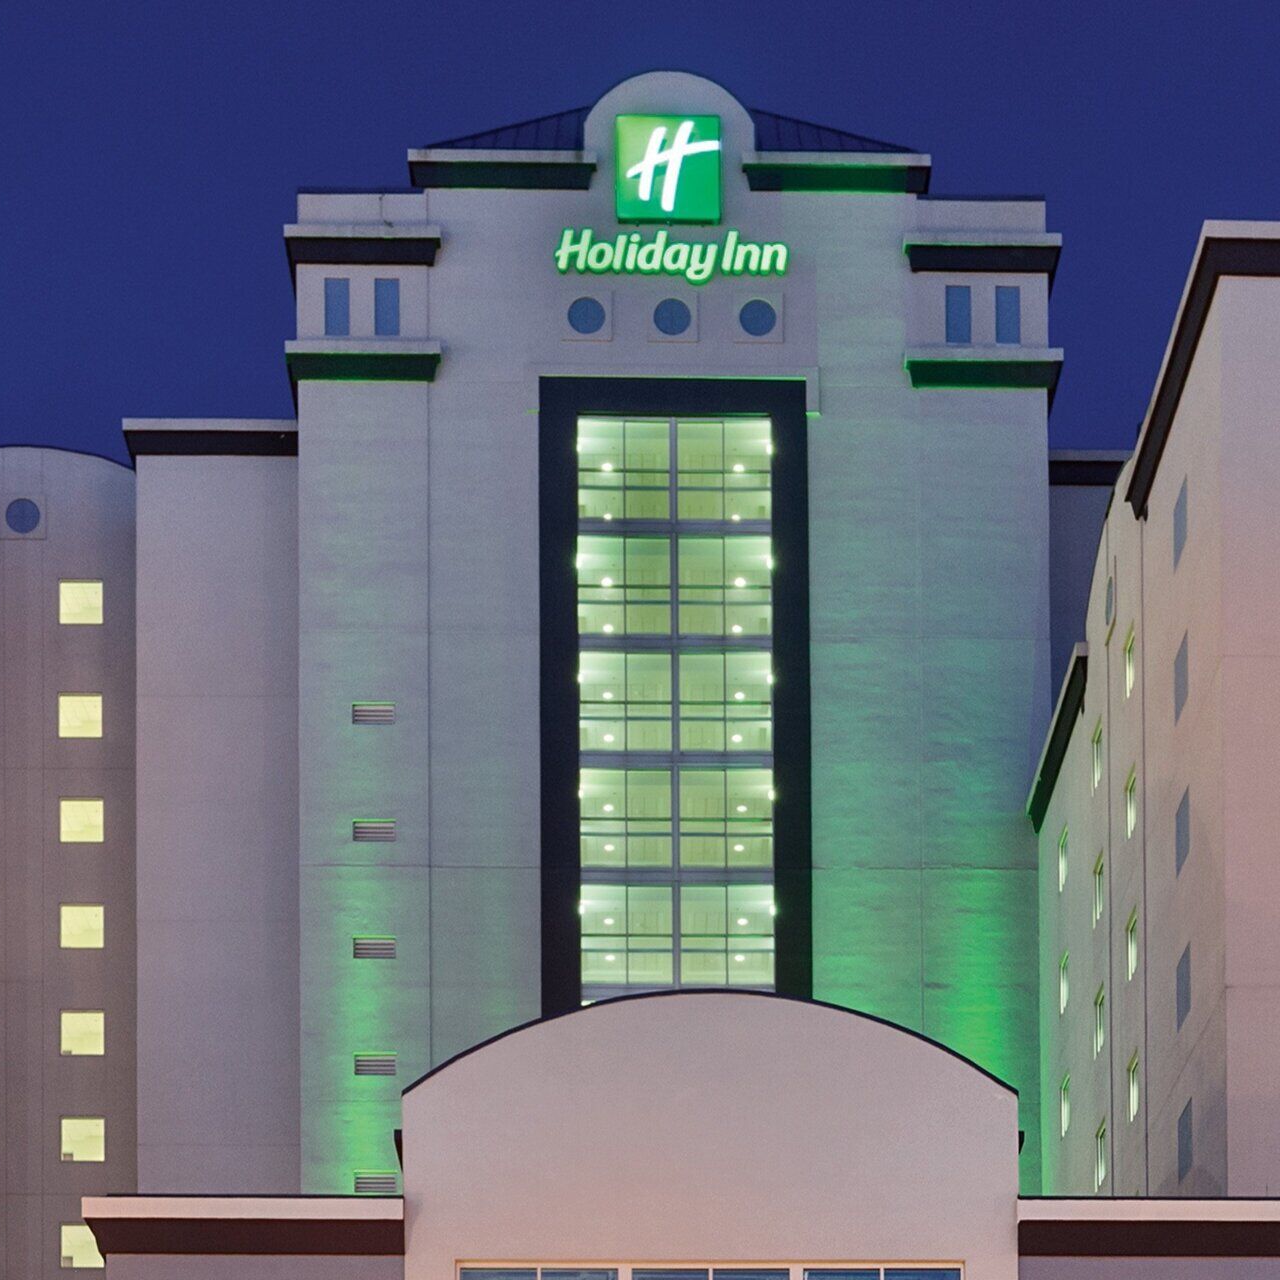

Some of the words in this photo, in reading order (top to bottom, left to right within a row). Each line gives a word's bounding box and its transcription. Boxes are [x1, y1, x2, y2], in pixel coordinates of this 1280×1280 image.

[626, 120, 721, 212] H
[554, 228, 718, 283] Holiday
[721, 230, 789, 274] Inn
